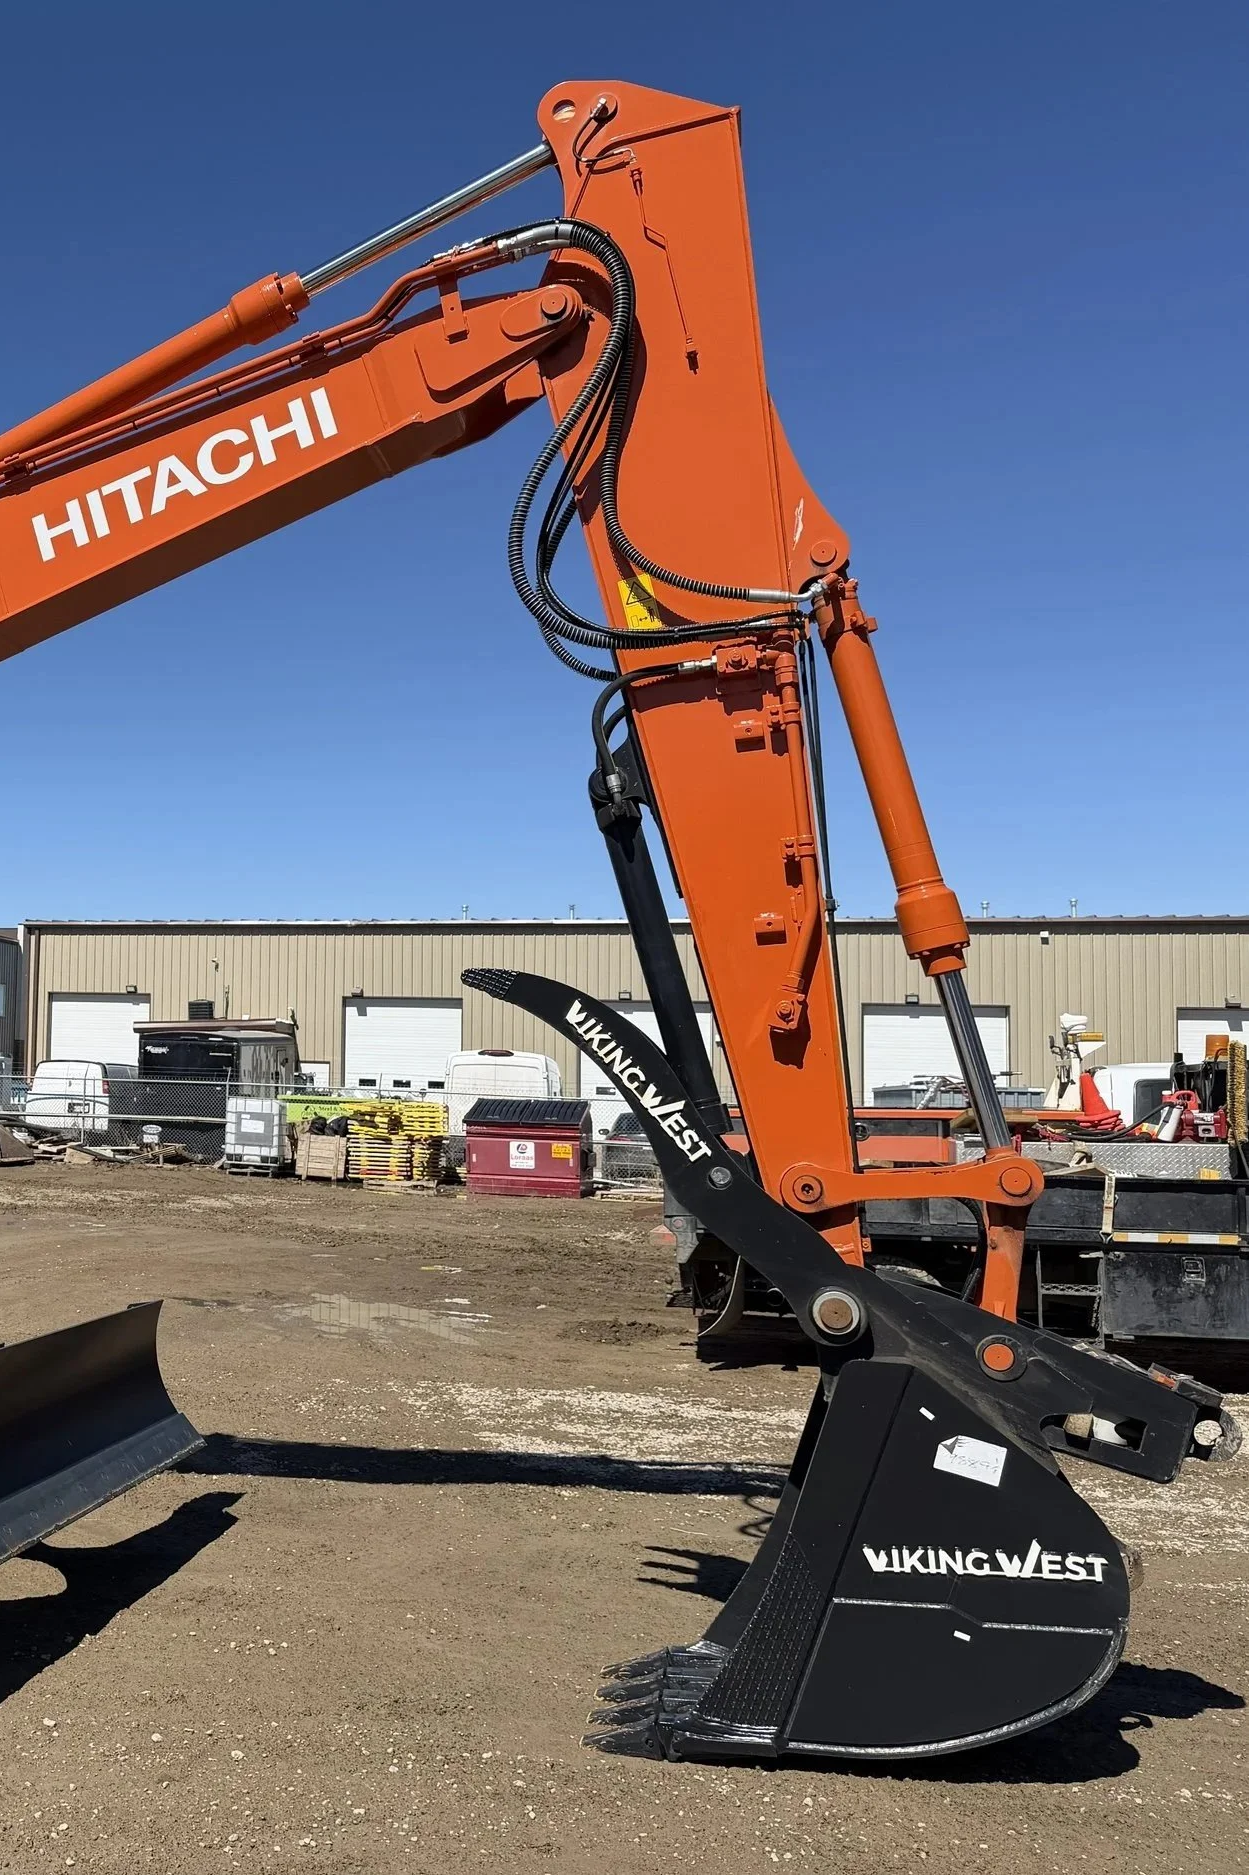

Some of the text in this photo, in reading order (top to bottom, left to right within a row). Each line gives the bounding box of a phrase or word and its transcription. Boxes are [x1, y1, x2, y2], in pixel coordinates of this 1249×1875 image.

[31, 387, 338, 562] HITACHI
[565, 999, 712, 1162] VIKING WEST
[862, 1539, 1109, 1582] VIKING WEST
